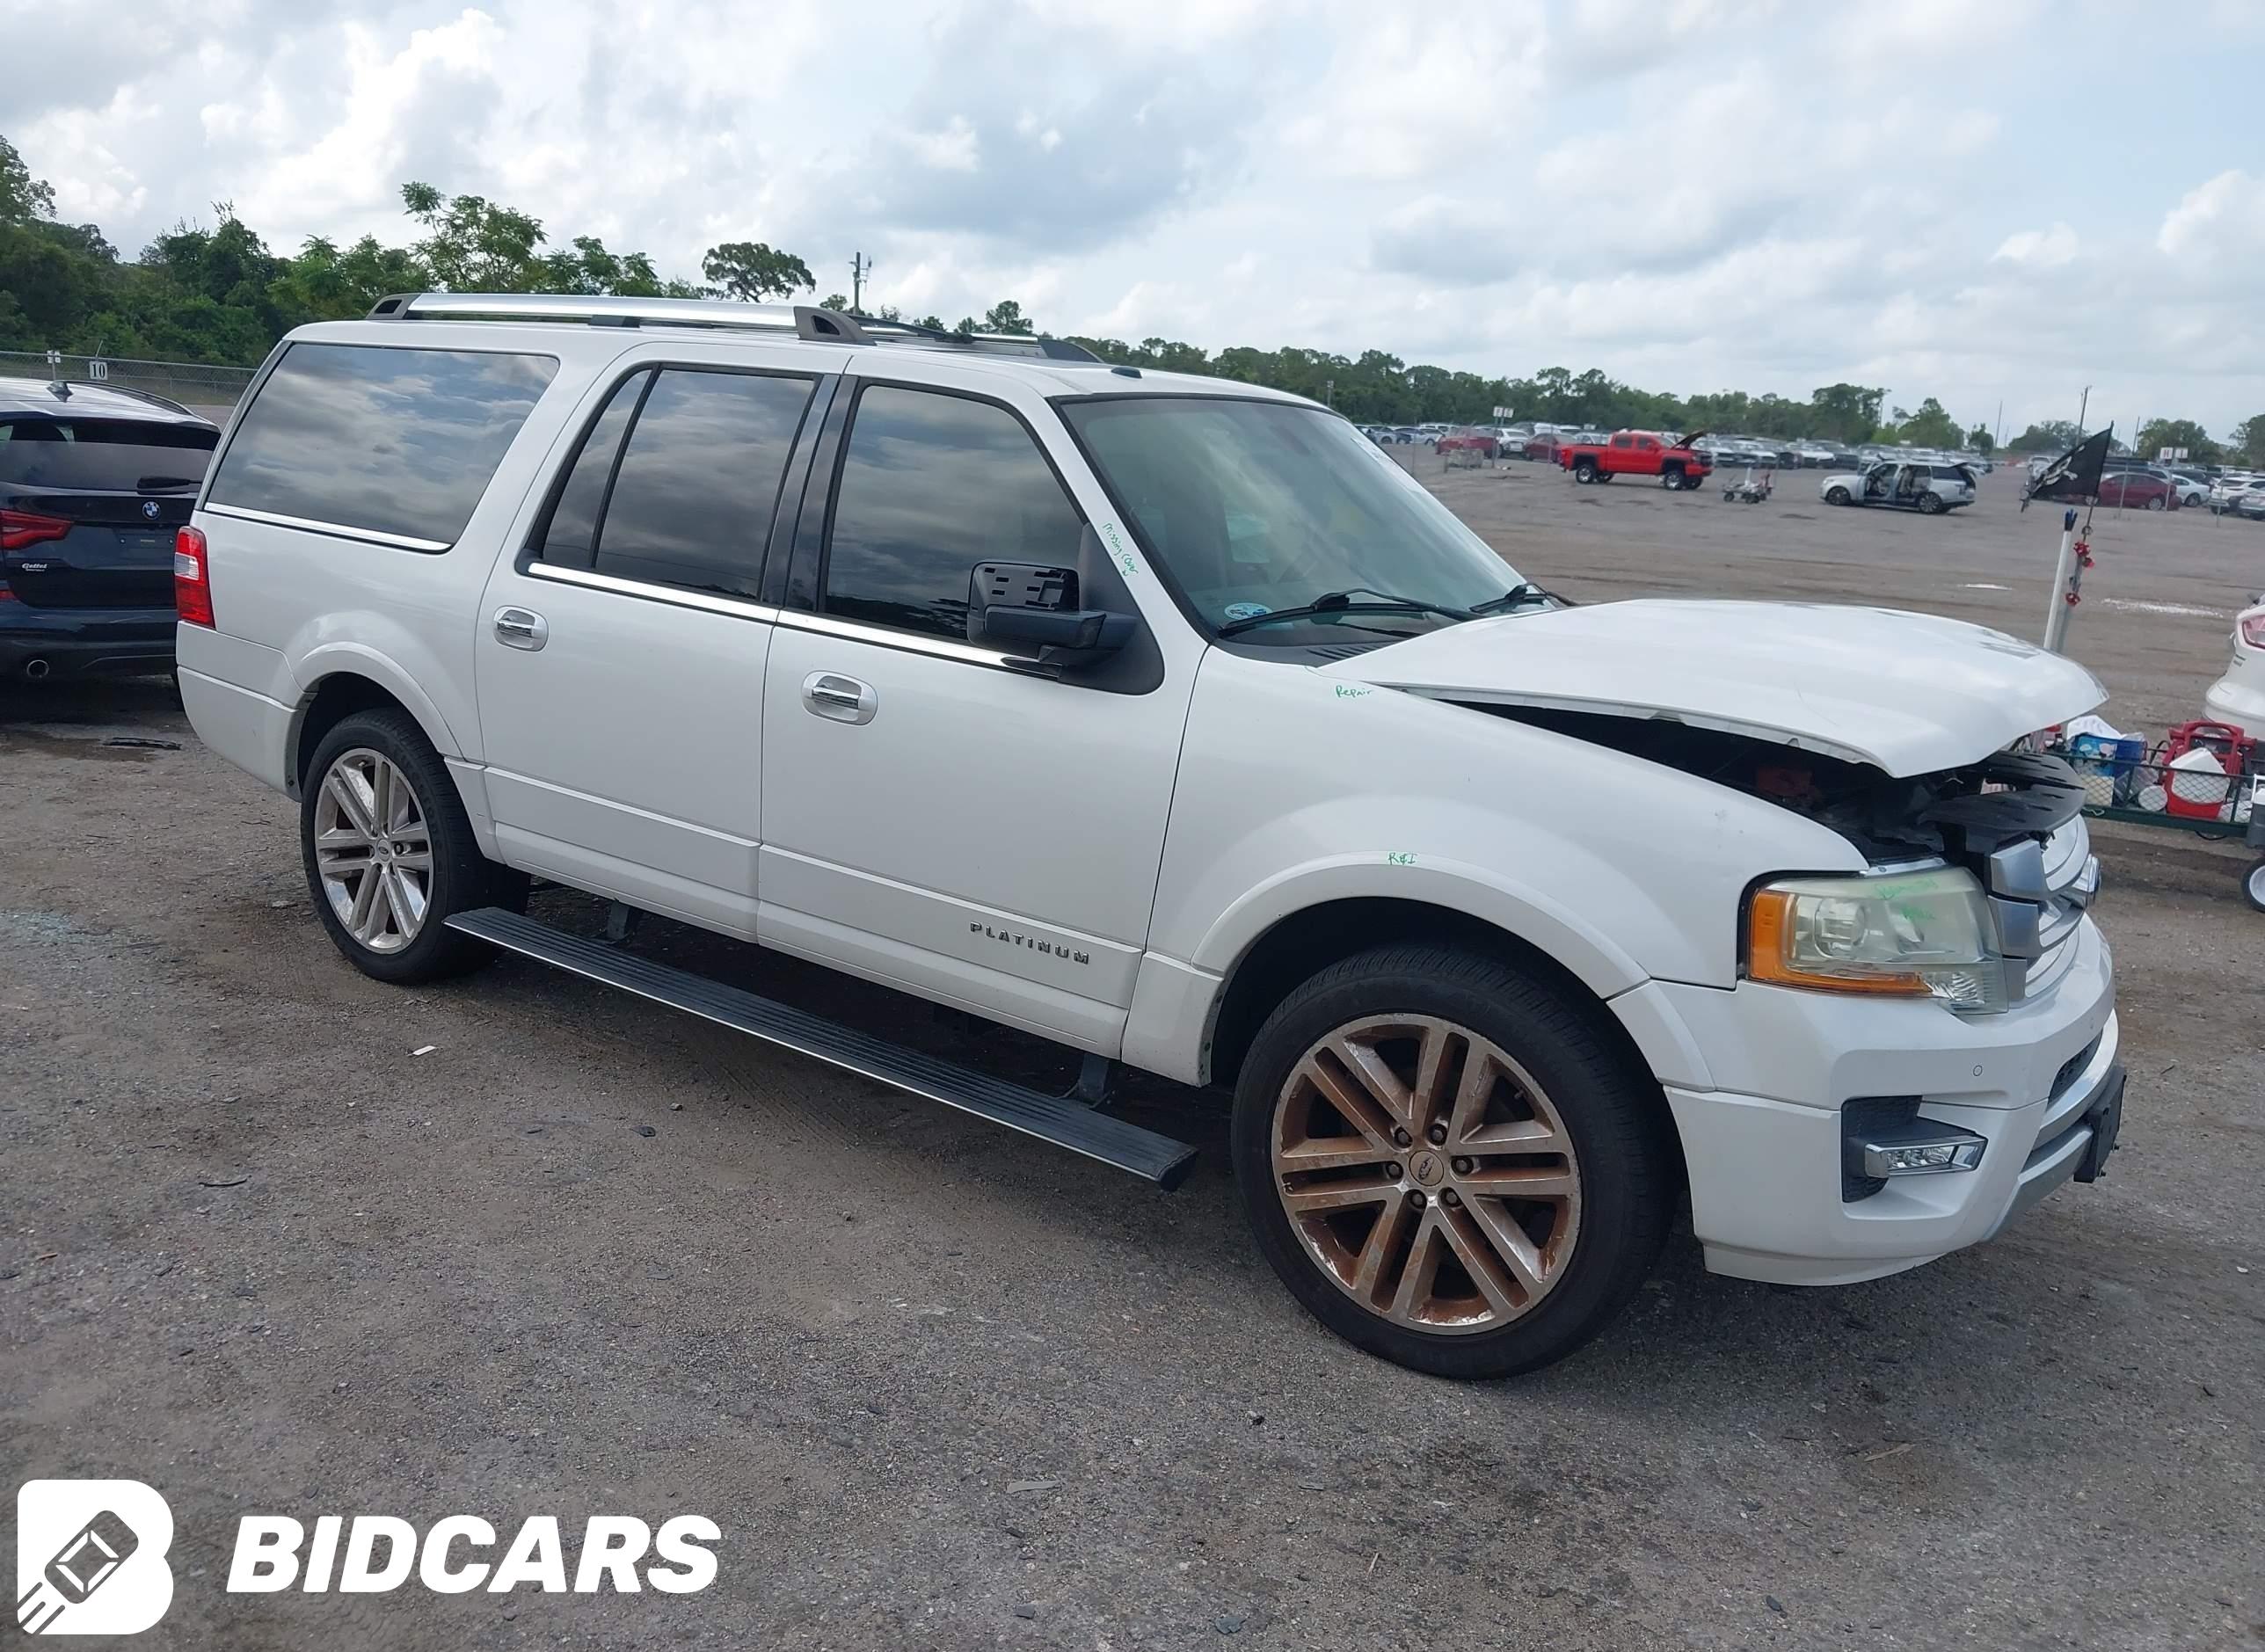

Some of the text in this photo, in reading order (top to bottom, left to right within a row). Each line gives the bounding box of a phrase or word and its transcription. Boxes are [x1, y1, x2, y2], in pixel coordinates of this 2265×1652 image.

[92, 364, 106, 378] 10
[1336, 685, 1373, 698] Repair
[970, 921, 1089, 964] PLATINUM
